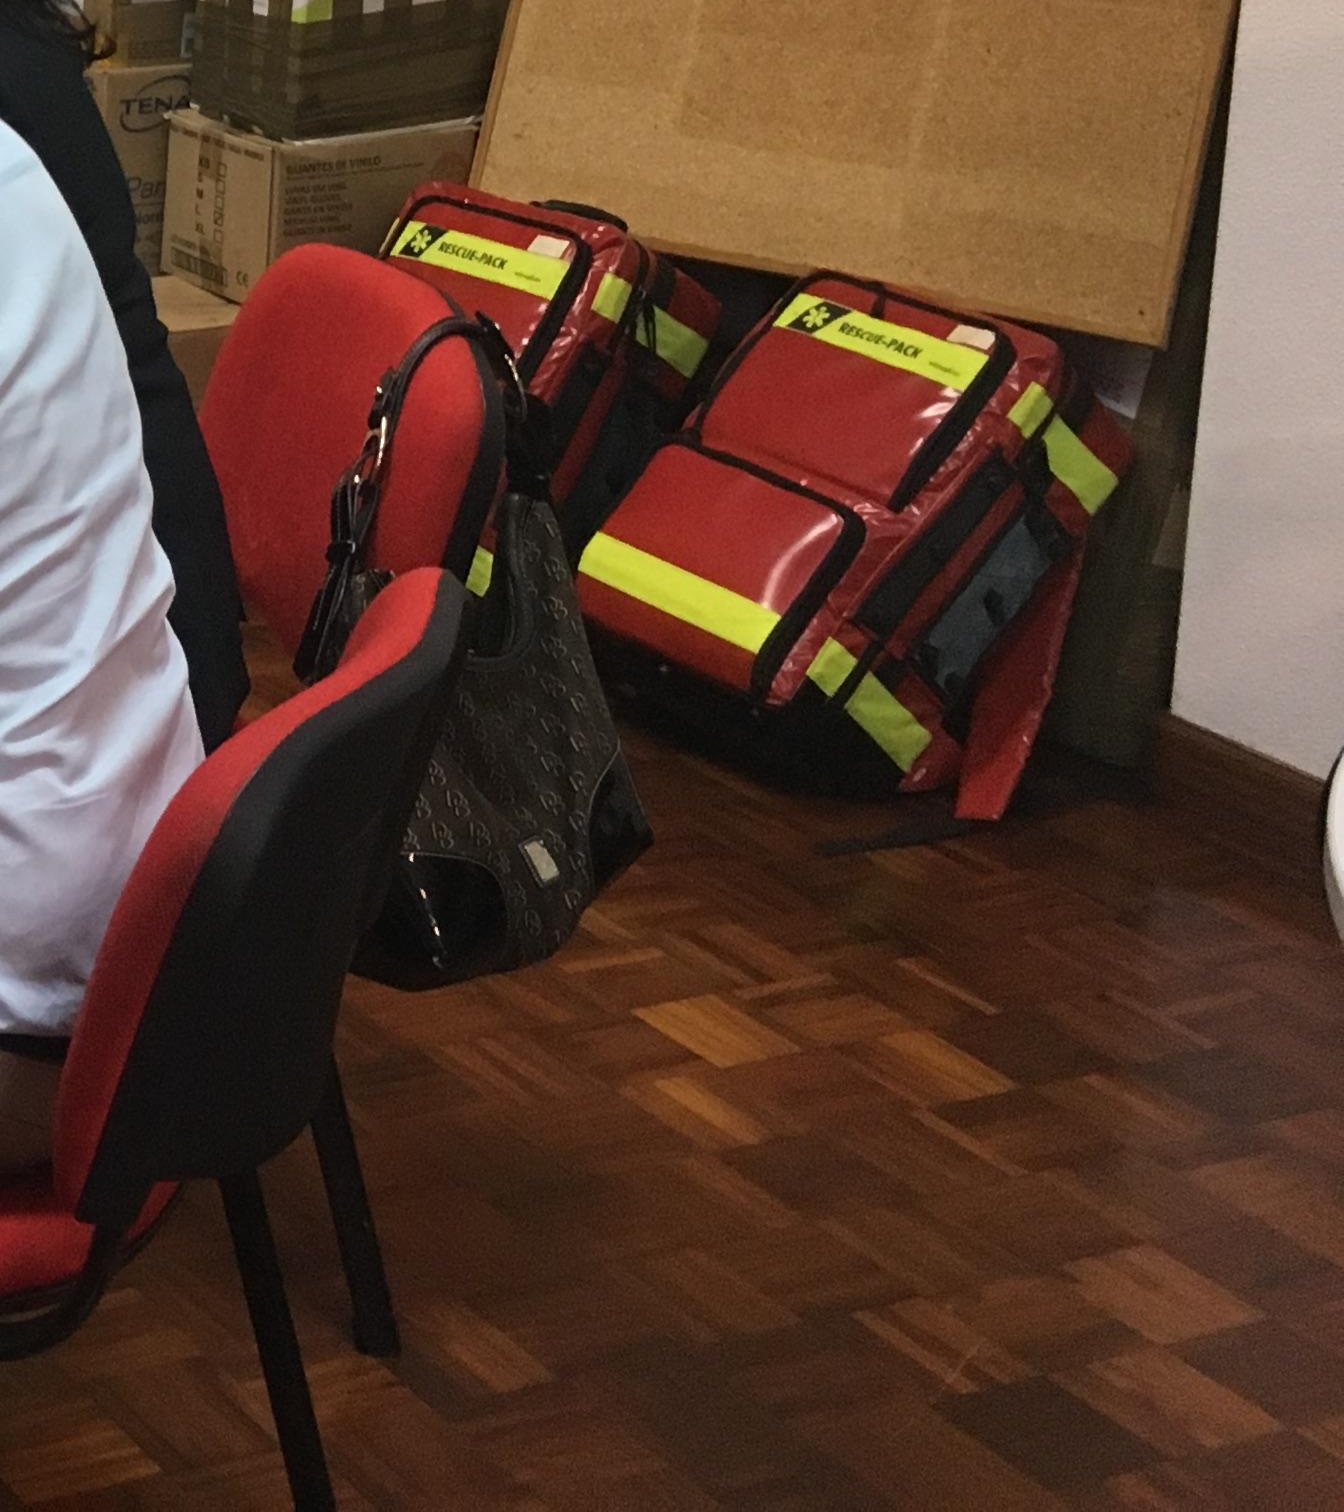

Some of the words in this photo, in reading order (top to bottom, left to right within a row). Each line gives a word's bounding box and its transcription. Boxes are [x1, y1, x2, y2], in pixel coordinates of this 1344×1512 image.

[120, 95, 191, 116] TENA
[437, 241, 508, 271] RESCUE-PACK
[838, 322, 924, 359] RESCUE-PACK
